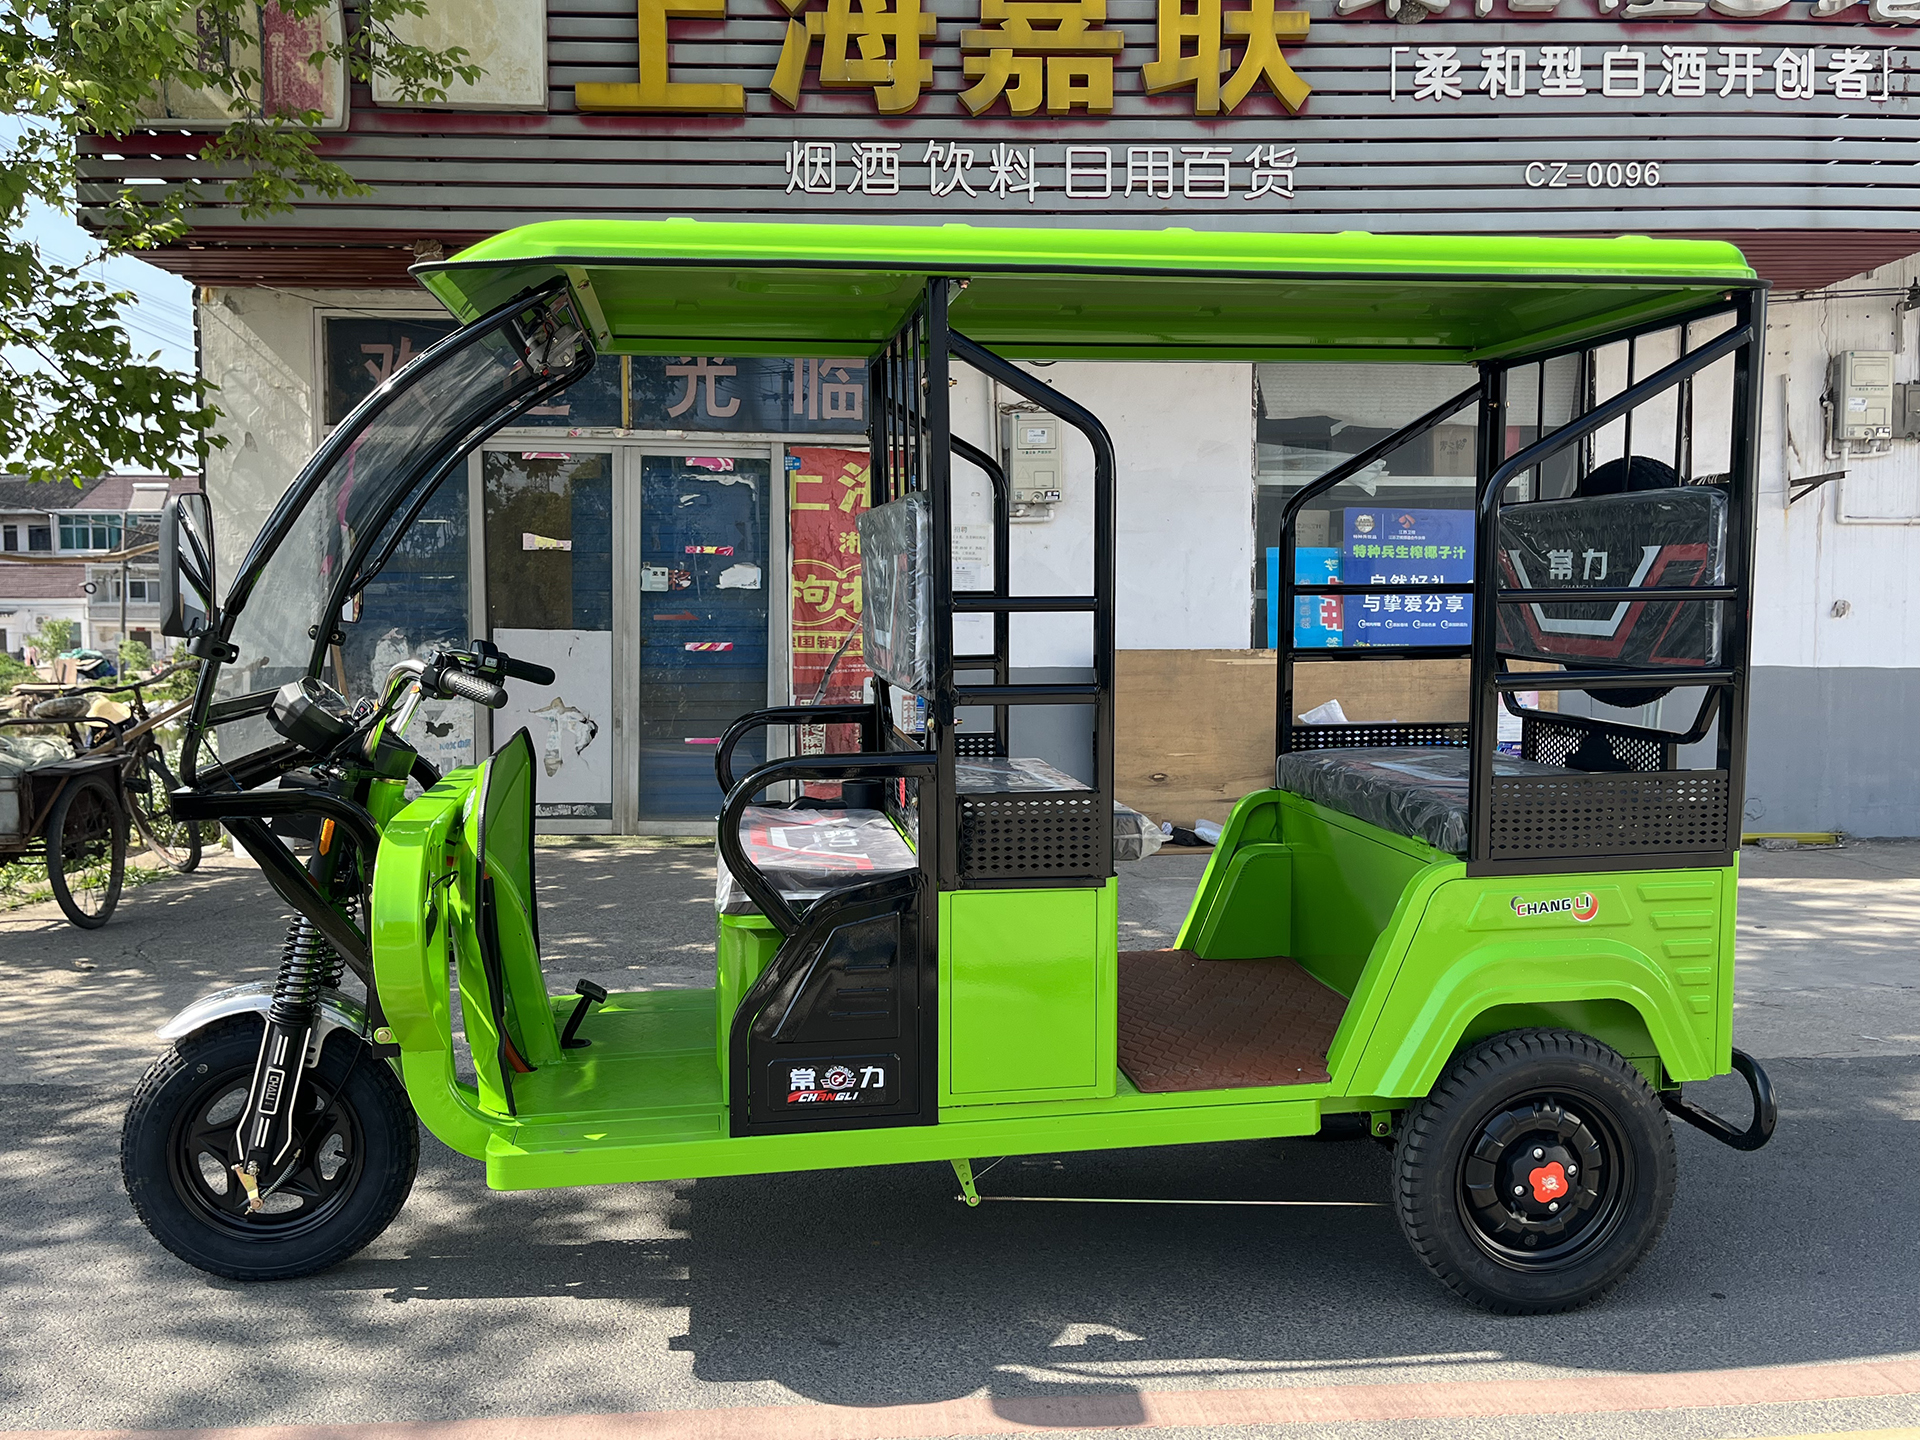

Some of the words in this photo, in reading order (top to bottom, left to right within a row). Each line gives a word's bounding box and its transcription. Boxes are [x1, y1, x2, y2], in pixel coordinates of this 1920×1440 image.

[1524, 161, 1661, 188] CZ-0096
[1352, 543, 1467, 560] 特种兵生榨椰子汁
[1547, 548, 1609, 581] 常力
[1362, 594, 1465, 613] 与挚爱分享
[797, 1091, 860, 1103] CHANGLI
